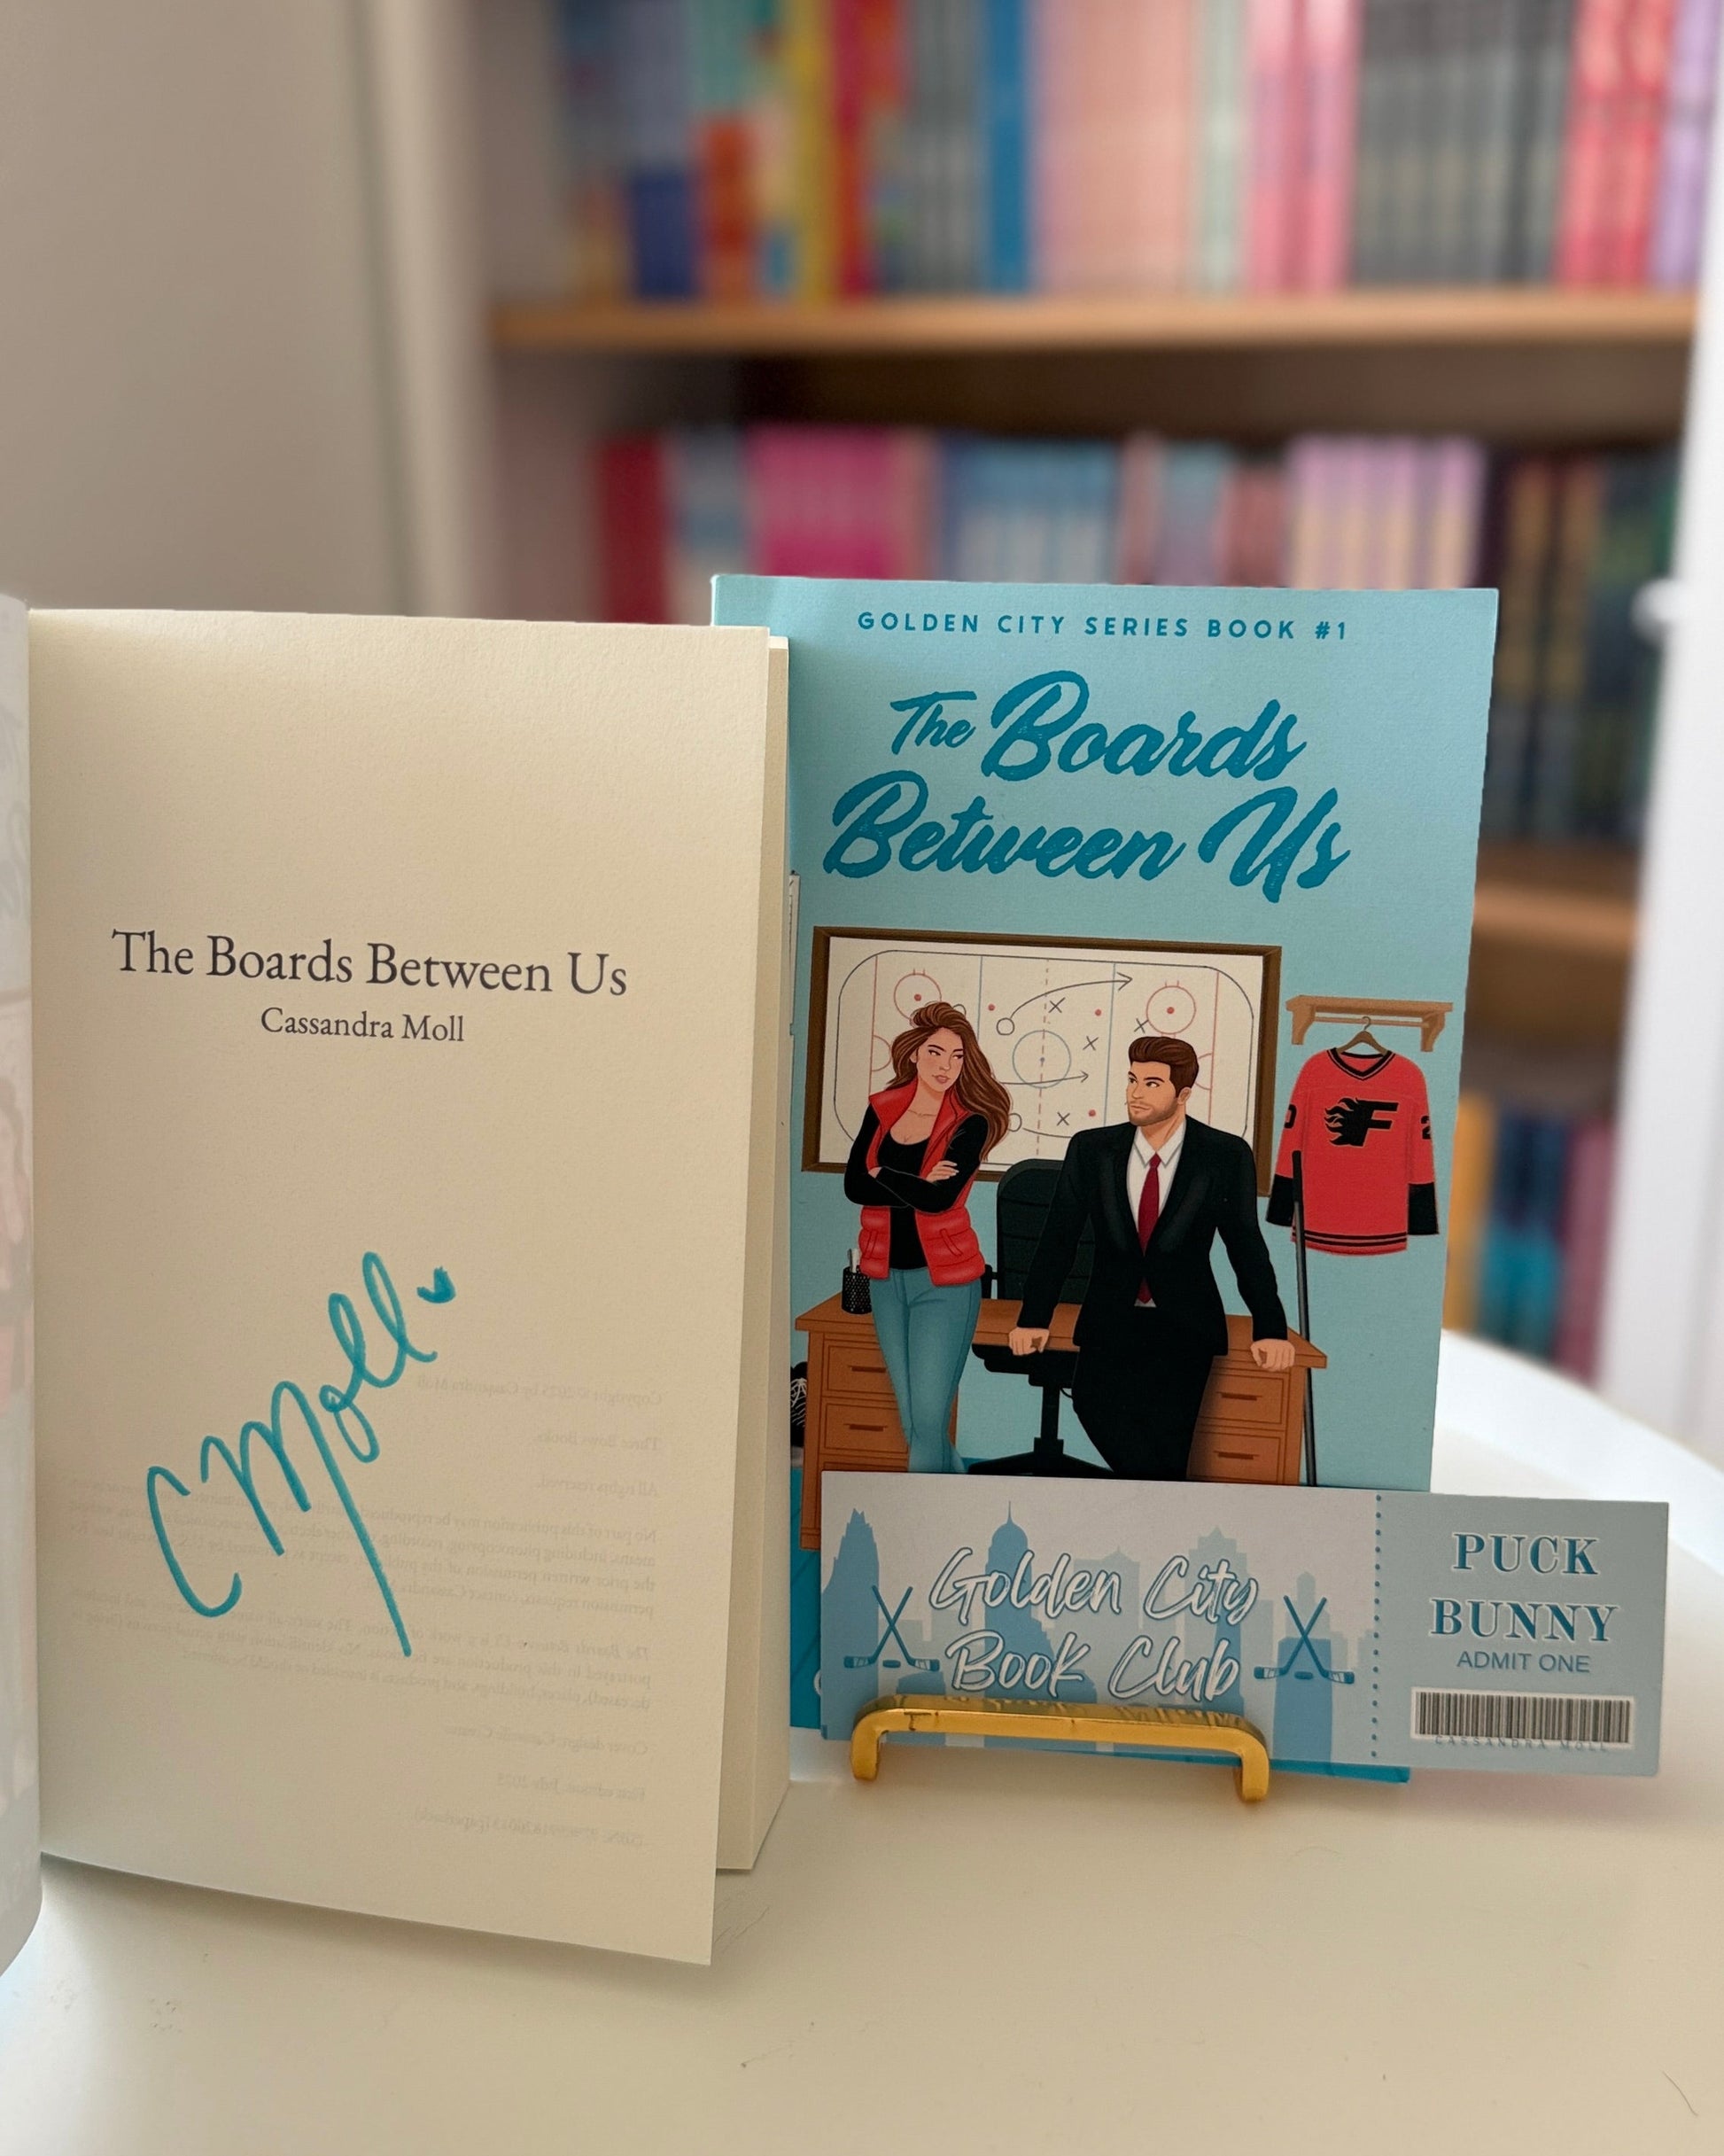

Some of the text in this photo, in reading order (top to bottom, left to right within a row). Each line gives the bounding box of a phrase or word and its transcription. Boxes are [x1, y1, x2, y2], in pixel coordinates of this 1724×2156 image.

[858, 611, 1345, 640] GOLDEN CITY SERIES BOOK #1
[889, 670, 1308, 782] The Boards
[822, 769, 1351, 904] Between Us
[111, 928, 626, 996] The Boards Between Us
[260, 1007, 464, 1042] Cassandra Moll
[1452, 1531, 1600, 1576] PUCK
[928, 1546, 1261, 1626] Golden City
[1429, 1597, 1620, 1643] BUNNY
[944, 1629, 1242, 1702] Book Club
[1456, 1650, 1592, 1674] ADMIT ONE
[1434, 1734, 1609, 1753] CASSANDRA MOLL
